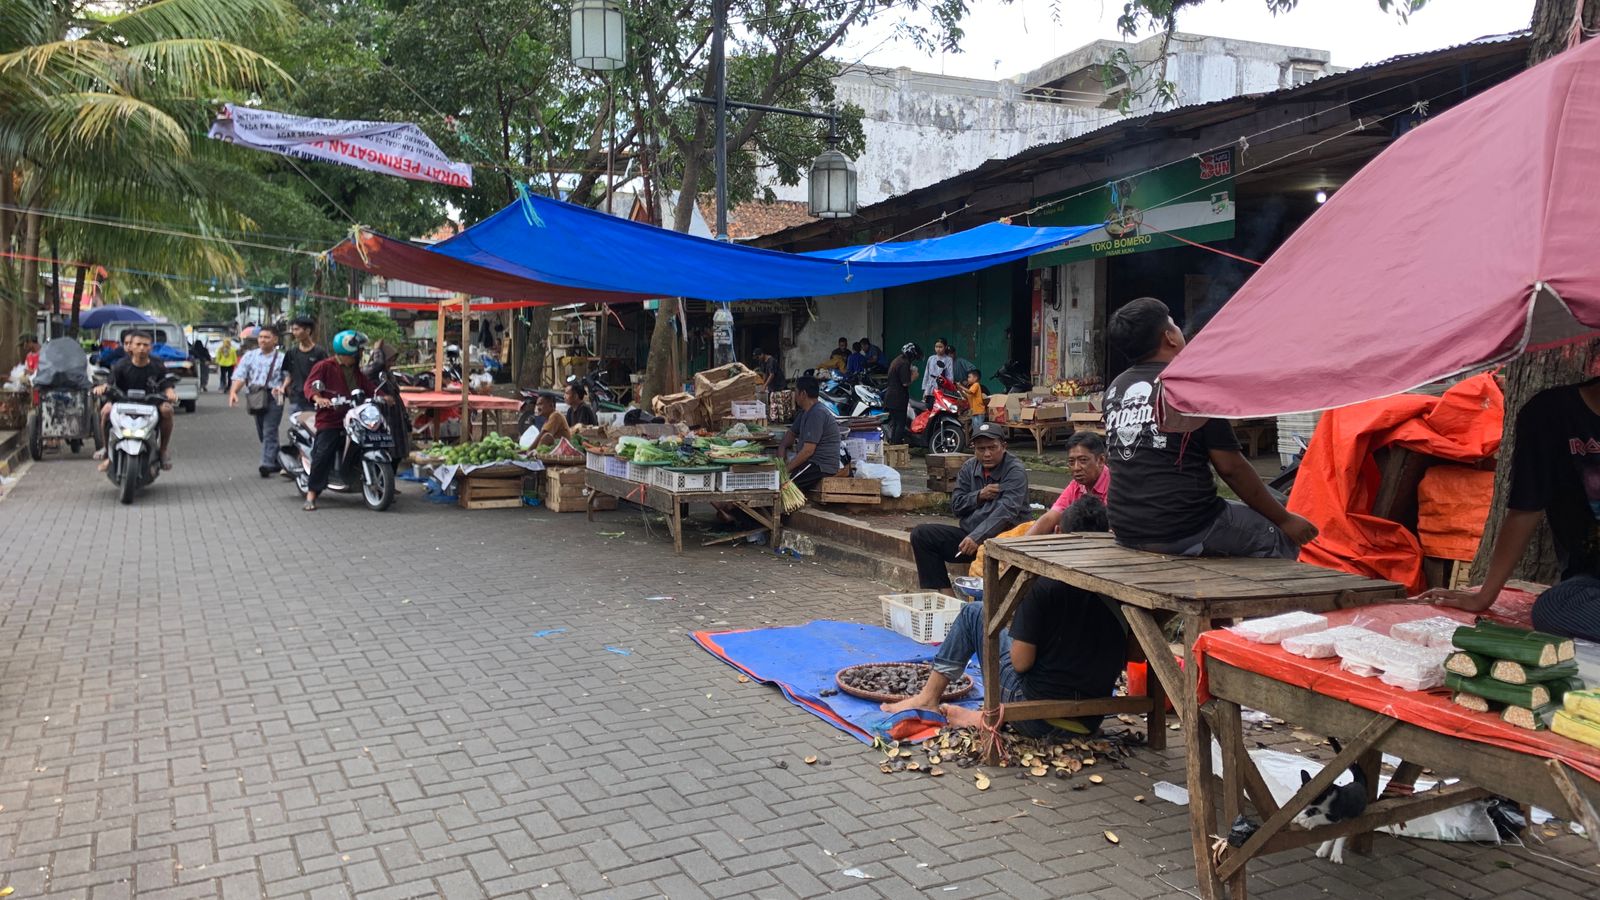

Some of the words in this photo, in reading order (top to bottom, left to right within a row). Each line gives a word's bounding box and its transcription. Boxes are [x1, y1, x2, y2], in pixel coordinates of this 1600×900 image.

[384, 139, 415, 153] TANGGAL
[404, 136, 430, 148] BOMERO
[328, 140, 421, 175] PERINGATAN
[416, 147, 435, 160] MULAI
[424, 167, 469, 188] SURAT
[1091, 241, 1112, 252] TOKO
[1114, 234, 1152, 249] BOMERO
